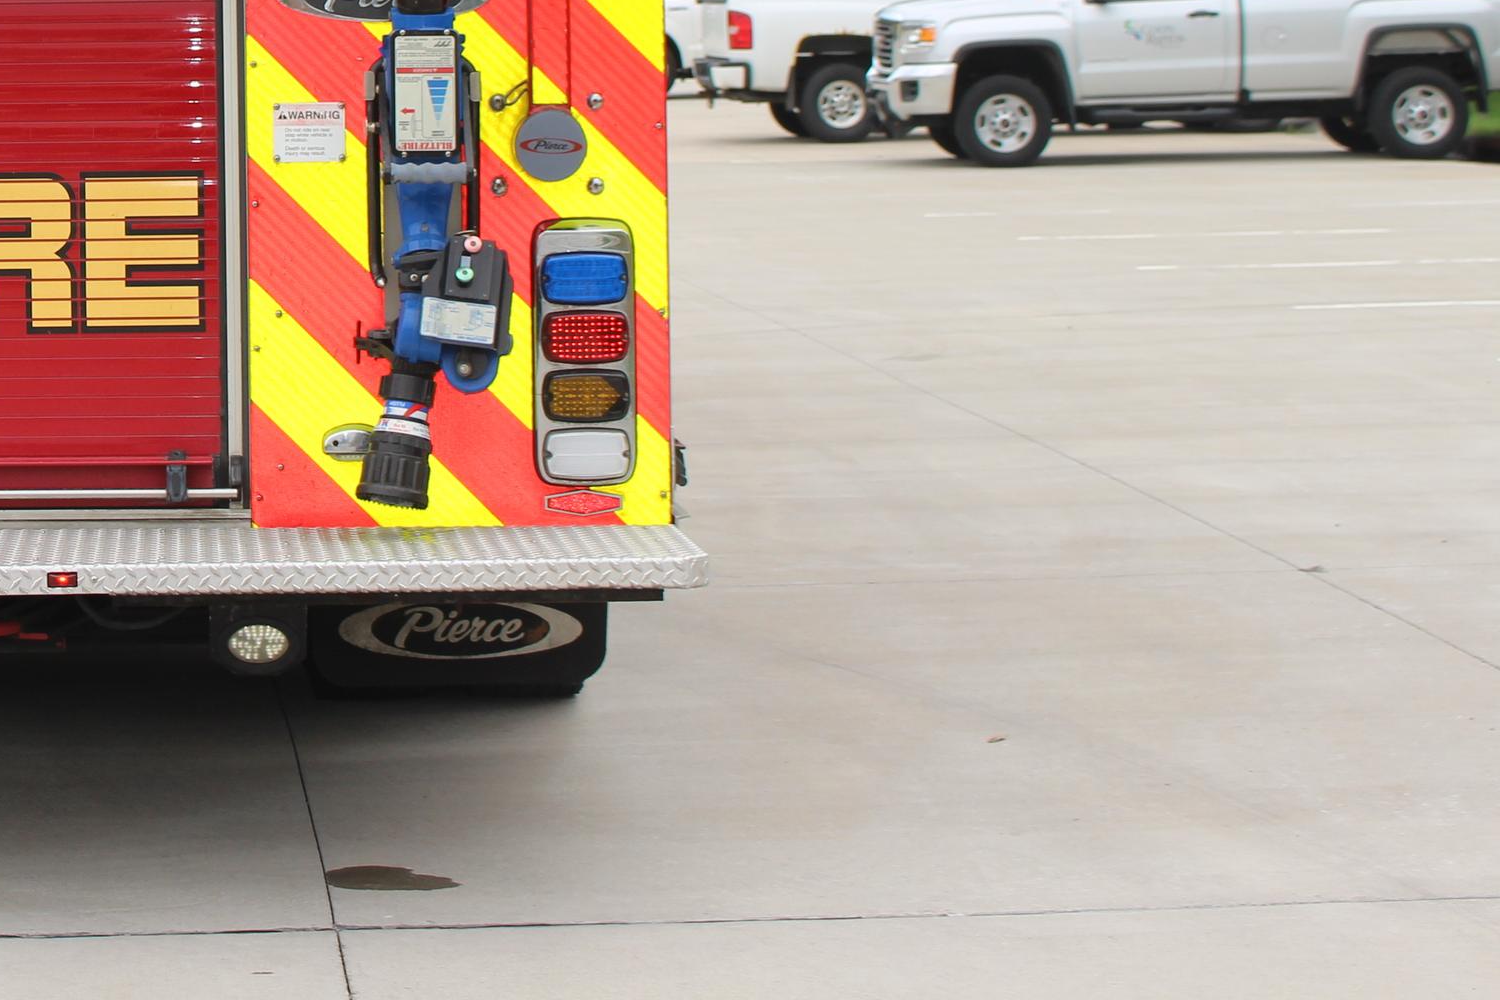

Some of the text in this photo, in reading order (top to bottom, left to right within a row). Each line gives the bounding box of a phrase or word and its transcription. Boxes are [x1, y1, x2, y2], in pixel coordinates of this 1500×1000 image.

[288, 110, 340, 120] WARNING
[534, 139, 569, 150] Pierce
[394, 606, 525, 649] Pierce
